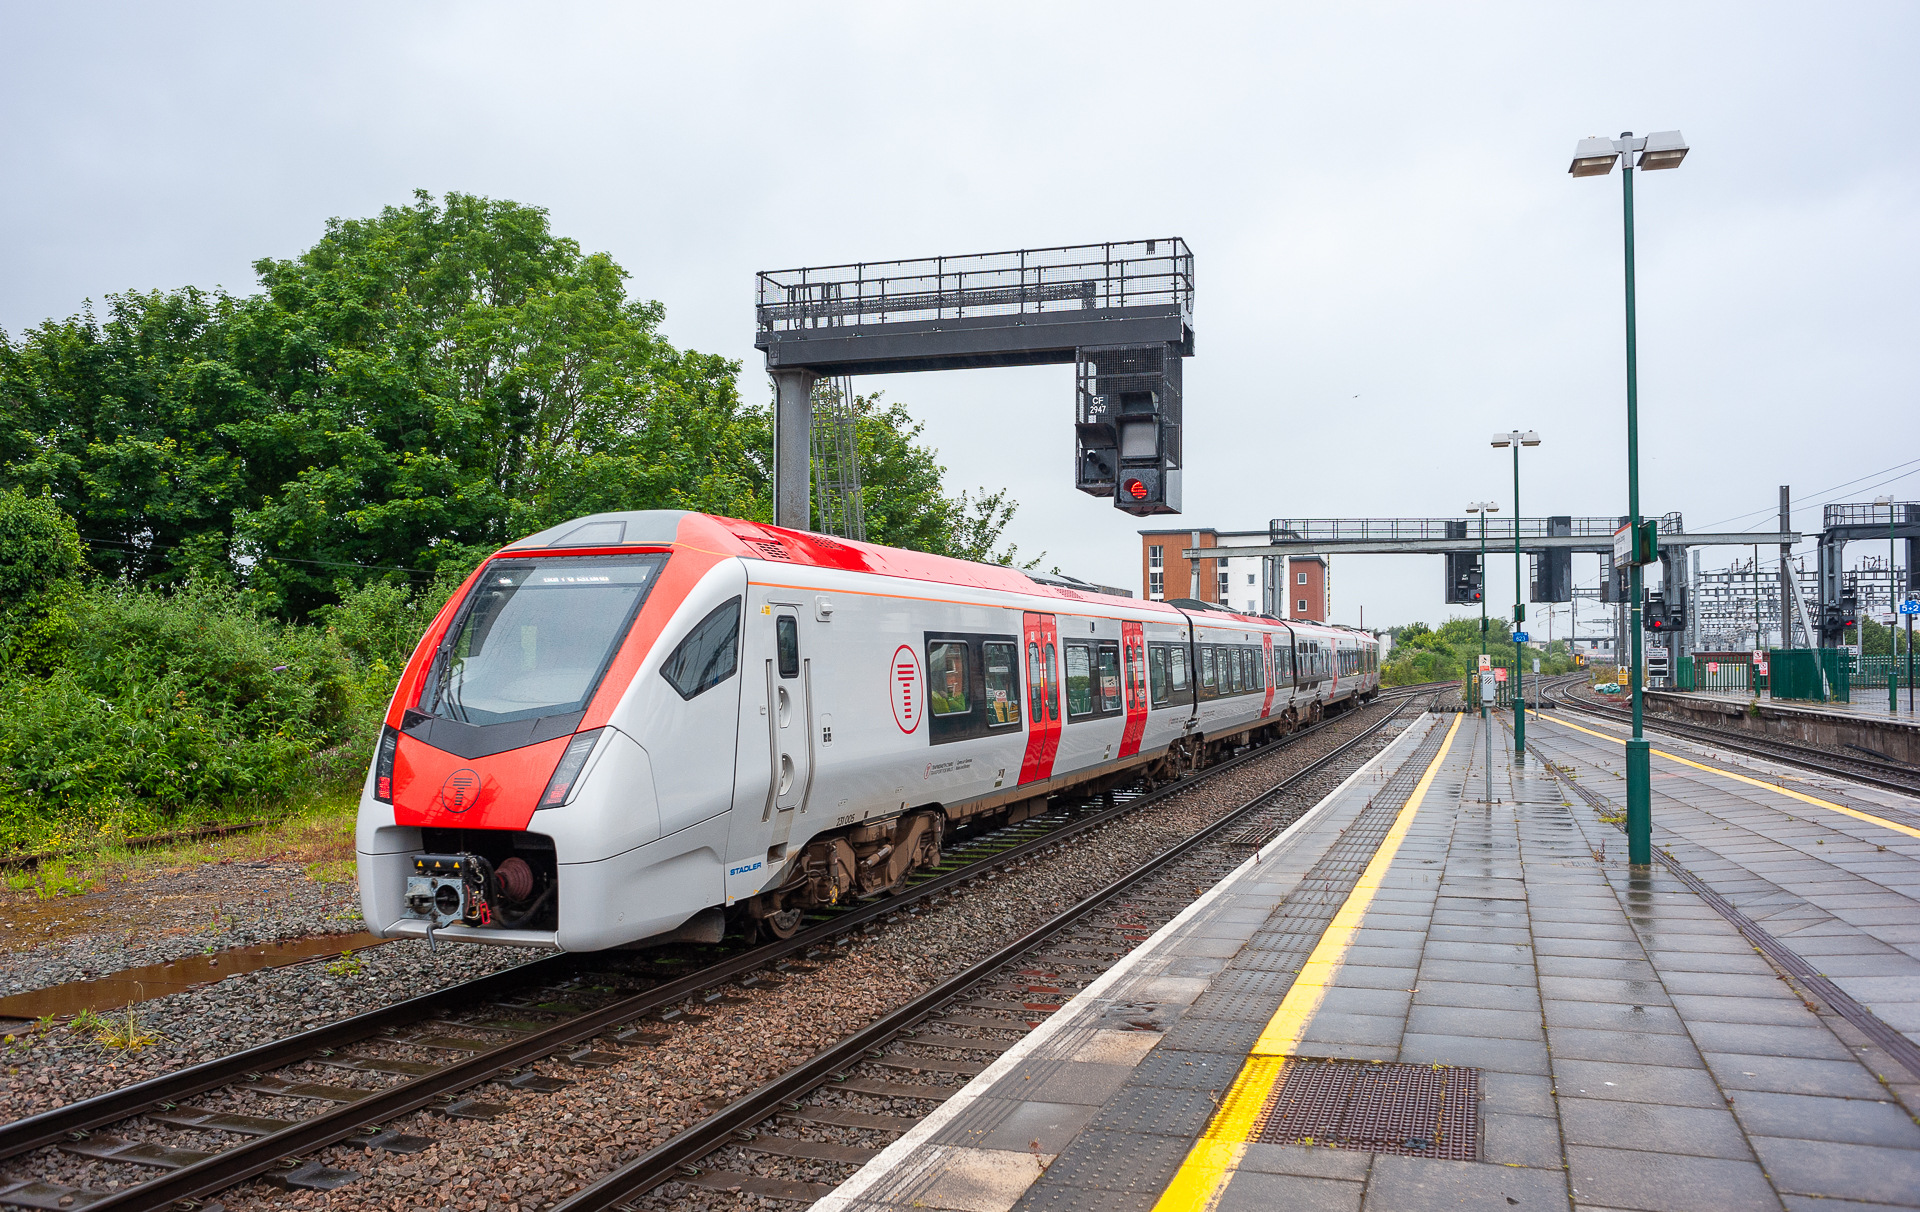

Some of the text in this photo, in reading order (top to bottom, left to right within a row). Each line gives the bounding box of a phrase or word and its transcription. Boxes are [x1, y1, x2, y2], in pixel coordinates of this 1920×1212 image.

[1092, 396, 1104, 405] CF
[1089, 405, 1106, 414] 2947
[729, 861, 762, 876] STADLER
